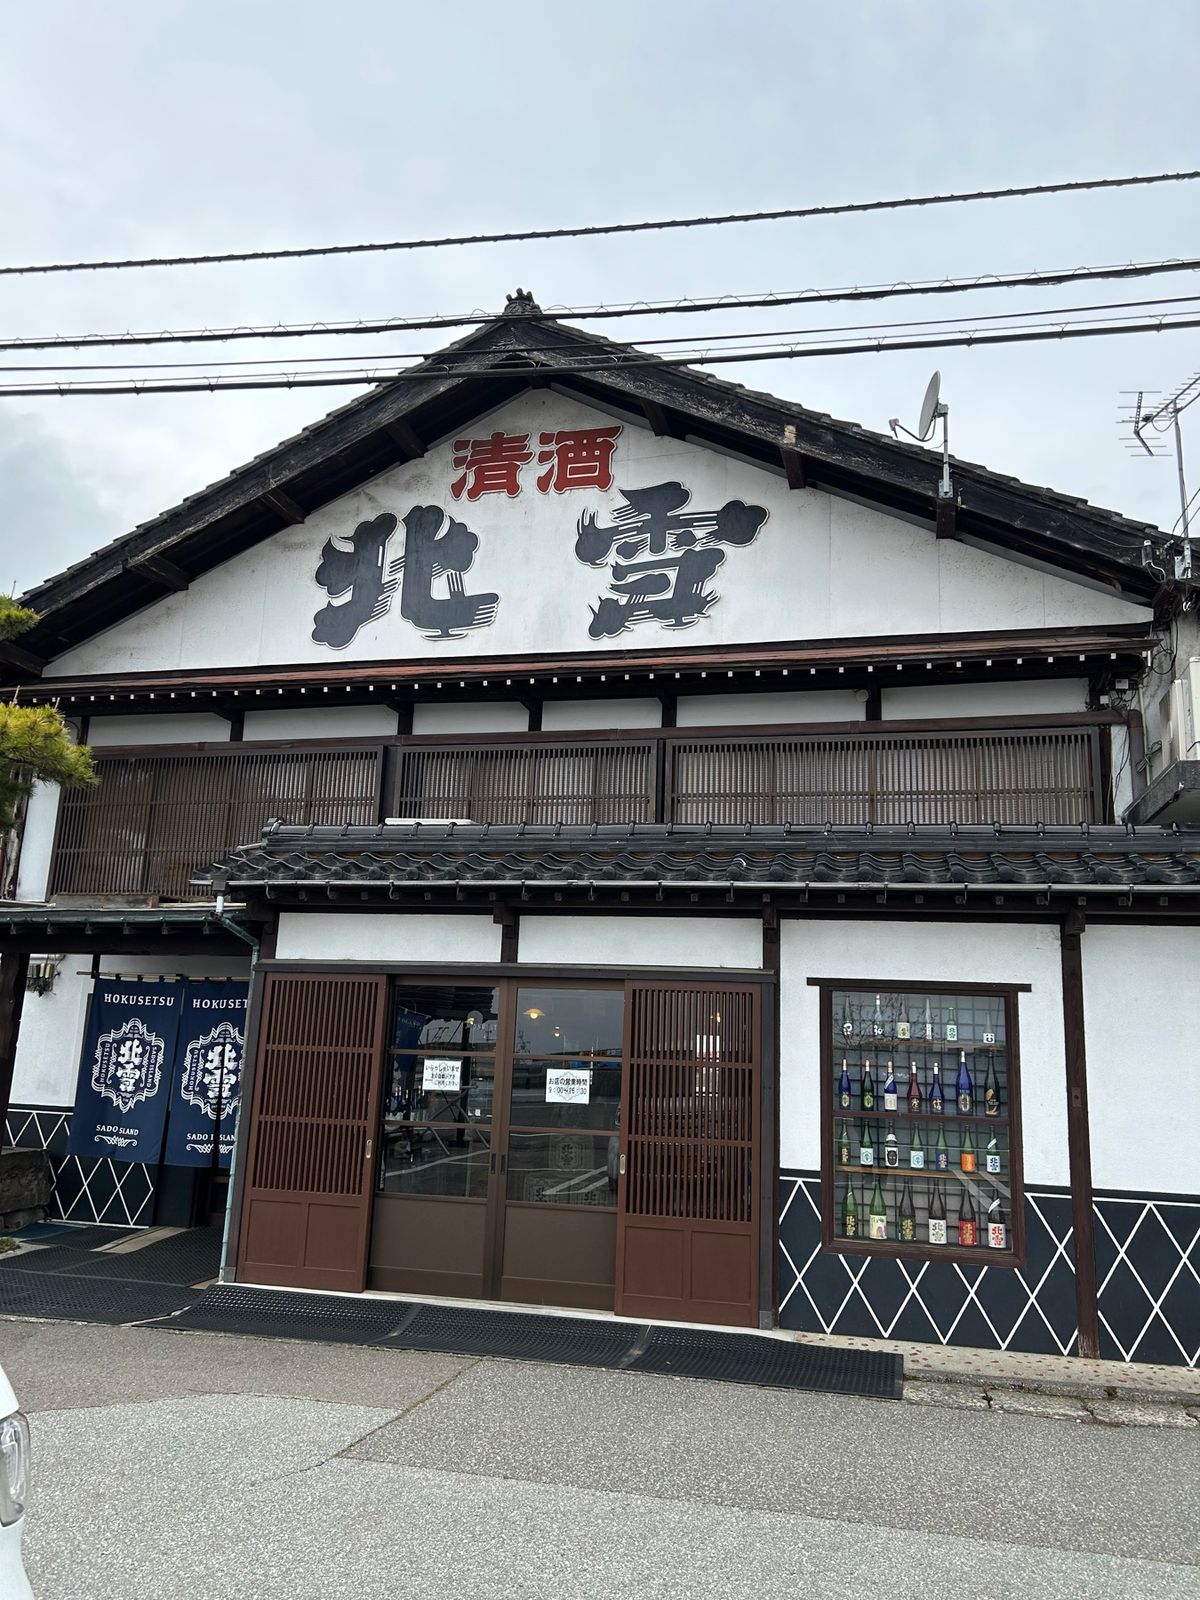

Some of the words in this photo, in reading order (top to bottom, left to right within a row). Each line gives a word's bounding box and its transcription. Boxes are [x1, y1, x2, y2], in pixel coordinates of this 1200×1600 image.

[451, 424, 624, 501] 清酒
[311, 481, 769, 650] 北雪
[104, 993, 175, 1006] HOKUSETSU
[116, 1038, 143, 1092] 北雪
[96, 1124, 119, 1133] SADO
[186, 1132, 208, 1141] SADO
